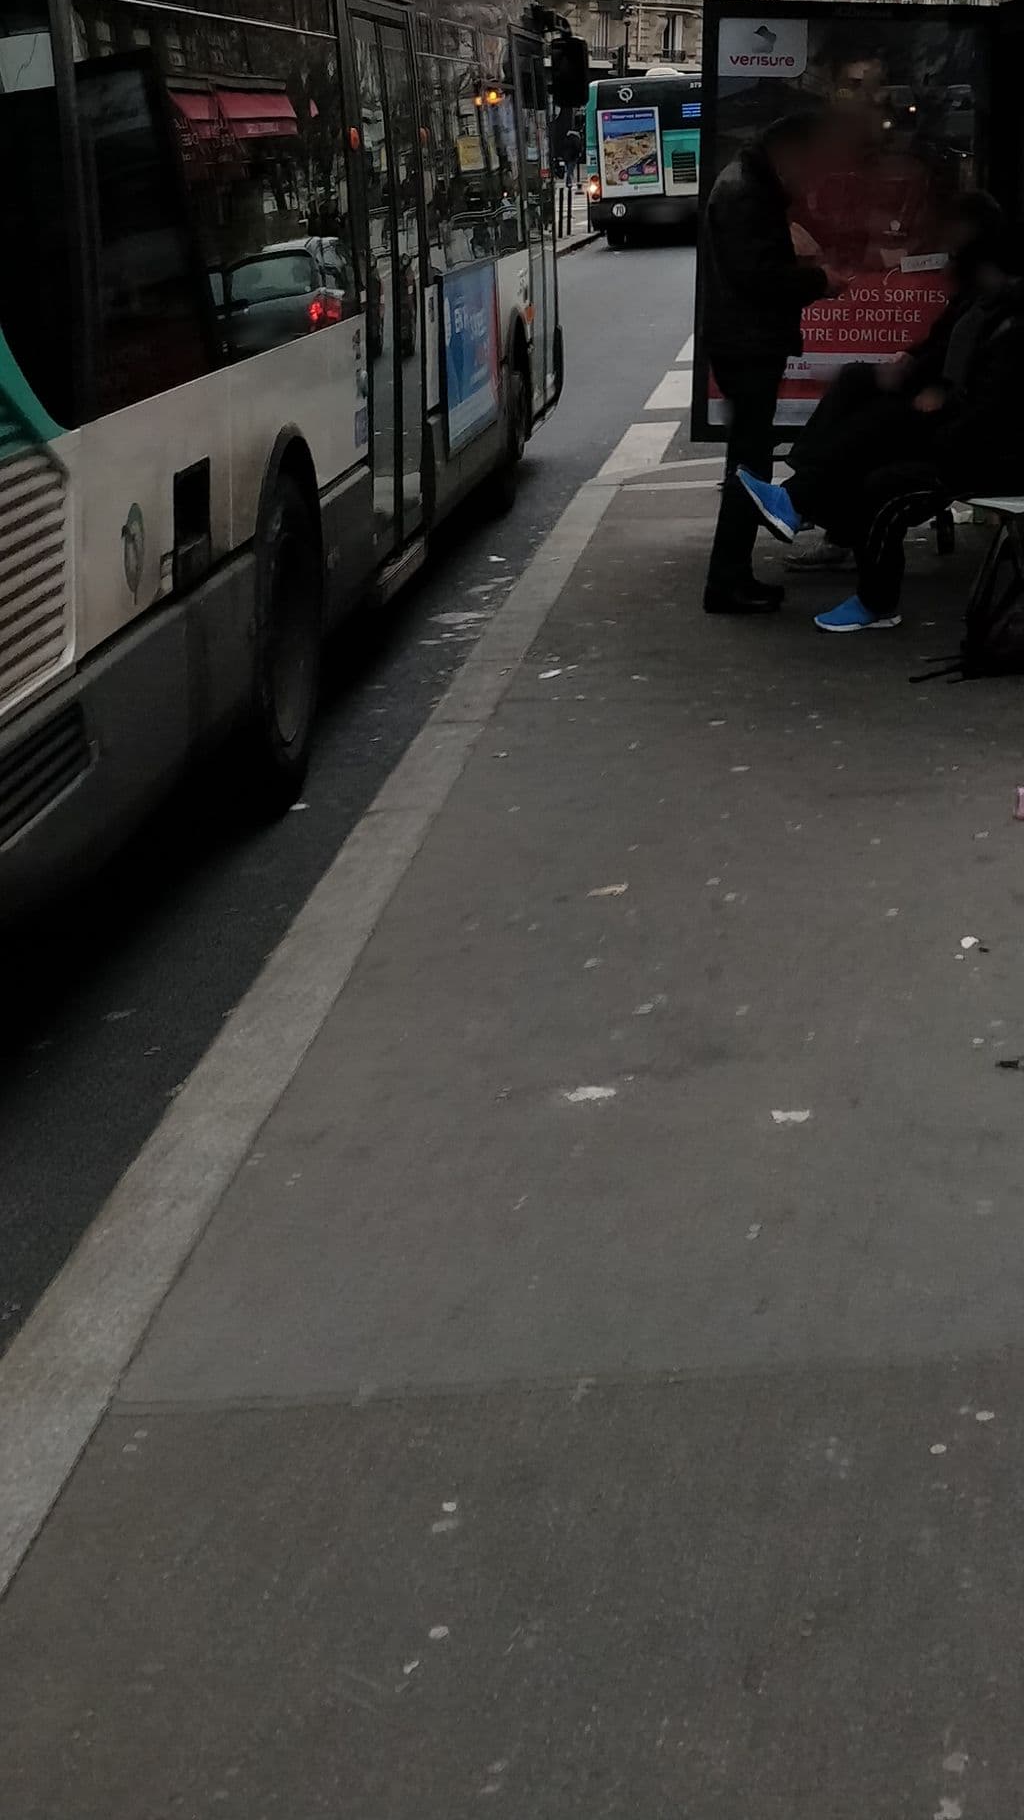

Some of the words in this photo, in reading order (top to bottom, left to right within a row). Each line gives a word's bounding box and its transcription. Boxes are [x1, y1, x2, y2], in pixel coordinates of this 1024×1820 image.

[729, 53, 795, 68] verisure
[850, 288, 880, 303] VOS
[800, 307, 850, 322] RISURE
[855, 306, 922, 323] PROTÈGE
[800, 328, 833, 342] OTRE
